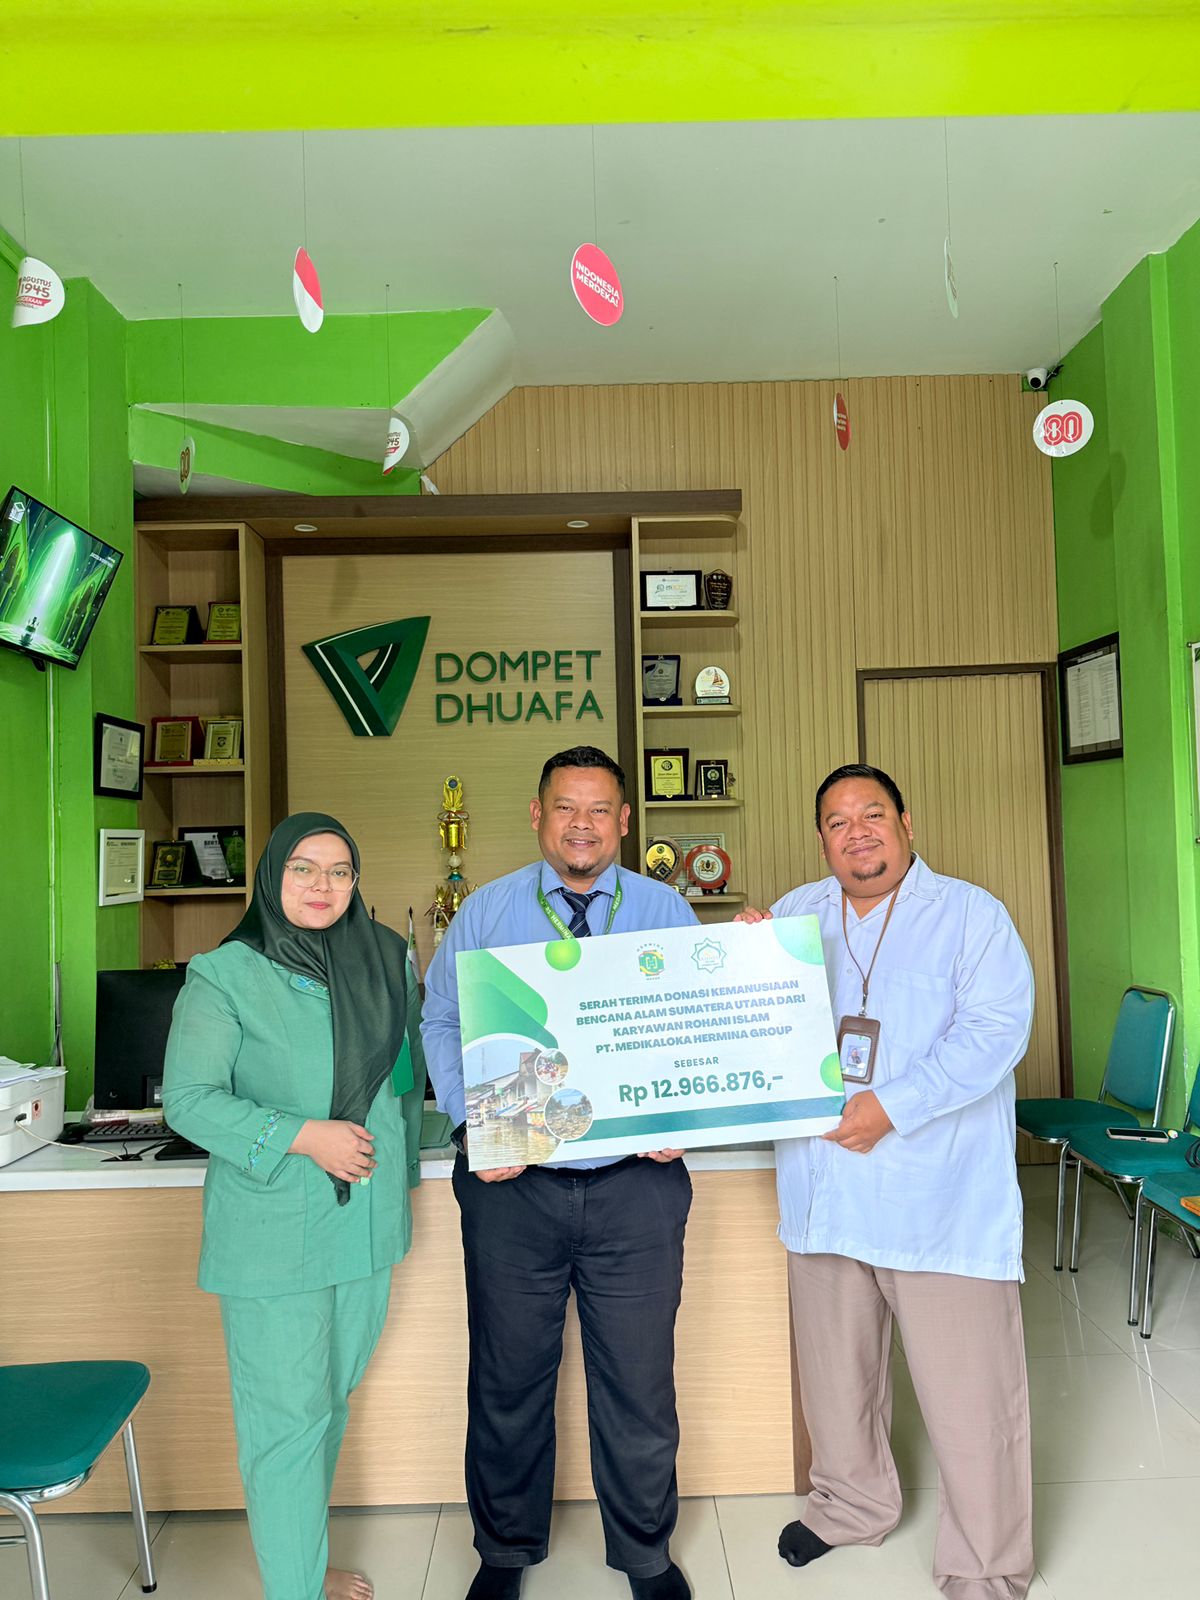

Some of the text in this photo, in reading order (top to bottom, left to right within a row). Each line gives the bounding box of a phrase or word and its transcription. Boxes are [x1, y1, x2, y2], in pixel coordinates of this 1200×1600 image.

[20, 283, 50, 298] 1945
[22, 275, 52, 288] AGUSTUS
[575, 260, 620, 300] INDONESIA
[576, 271, 619, 307] MERDEKA!
[1043, 411, 1083, 446] 80
[435, 650, 602, 683] DOMPET
[435, 689, 604, 723] DHUAFA
[576, 994, 806, 1026] BENCANA ALAM SUMATERA UTARA DARI
[579, 980, 800, 1011] SERAH TERIMA DONASI KEMANUSIAAN
[595, 1025, 793, 1054] PT. MEDIKALOKA HERMINA GROUP
[613, 1012, 770, 1037] KARYAWAN ROHANI ISLAM
[673, 1056, 719, 1068] SEBESAR
[618, 1069, 784, 1107] Rp 12.966.876,-
